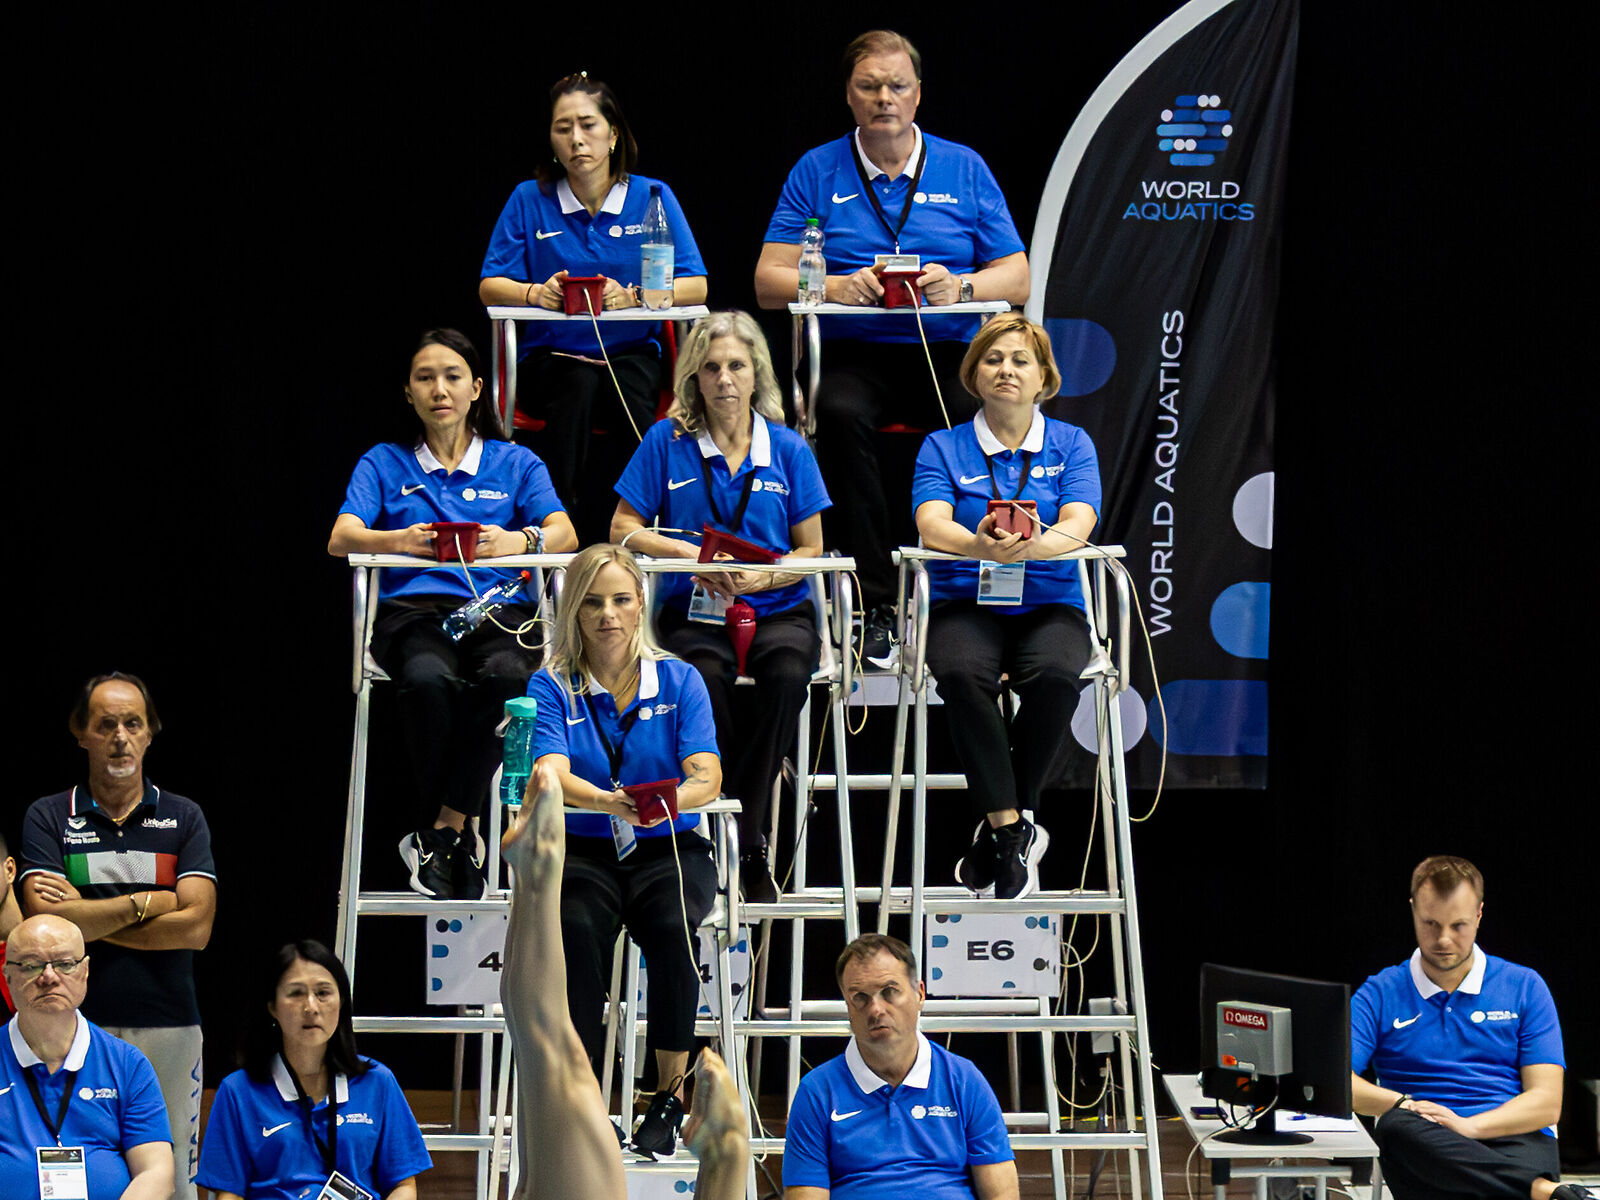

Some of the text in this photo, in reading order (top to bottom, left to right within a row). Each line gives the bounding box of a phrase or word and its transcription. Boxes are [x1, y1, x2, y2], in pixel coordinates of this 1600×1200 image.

[1142, 181, 1240, 199] WORLD
[1123, 203, 1255, 221] AQUATICS
[1150, 309, 1185, 638] WORLD AQUATICS
[967, 939, 1015, 961] E6
[478, 951, 503, 972] 4
[1235, 1012, 1265, 1028] OMEGA
